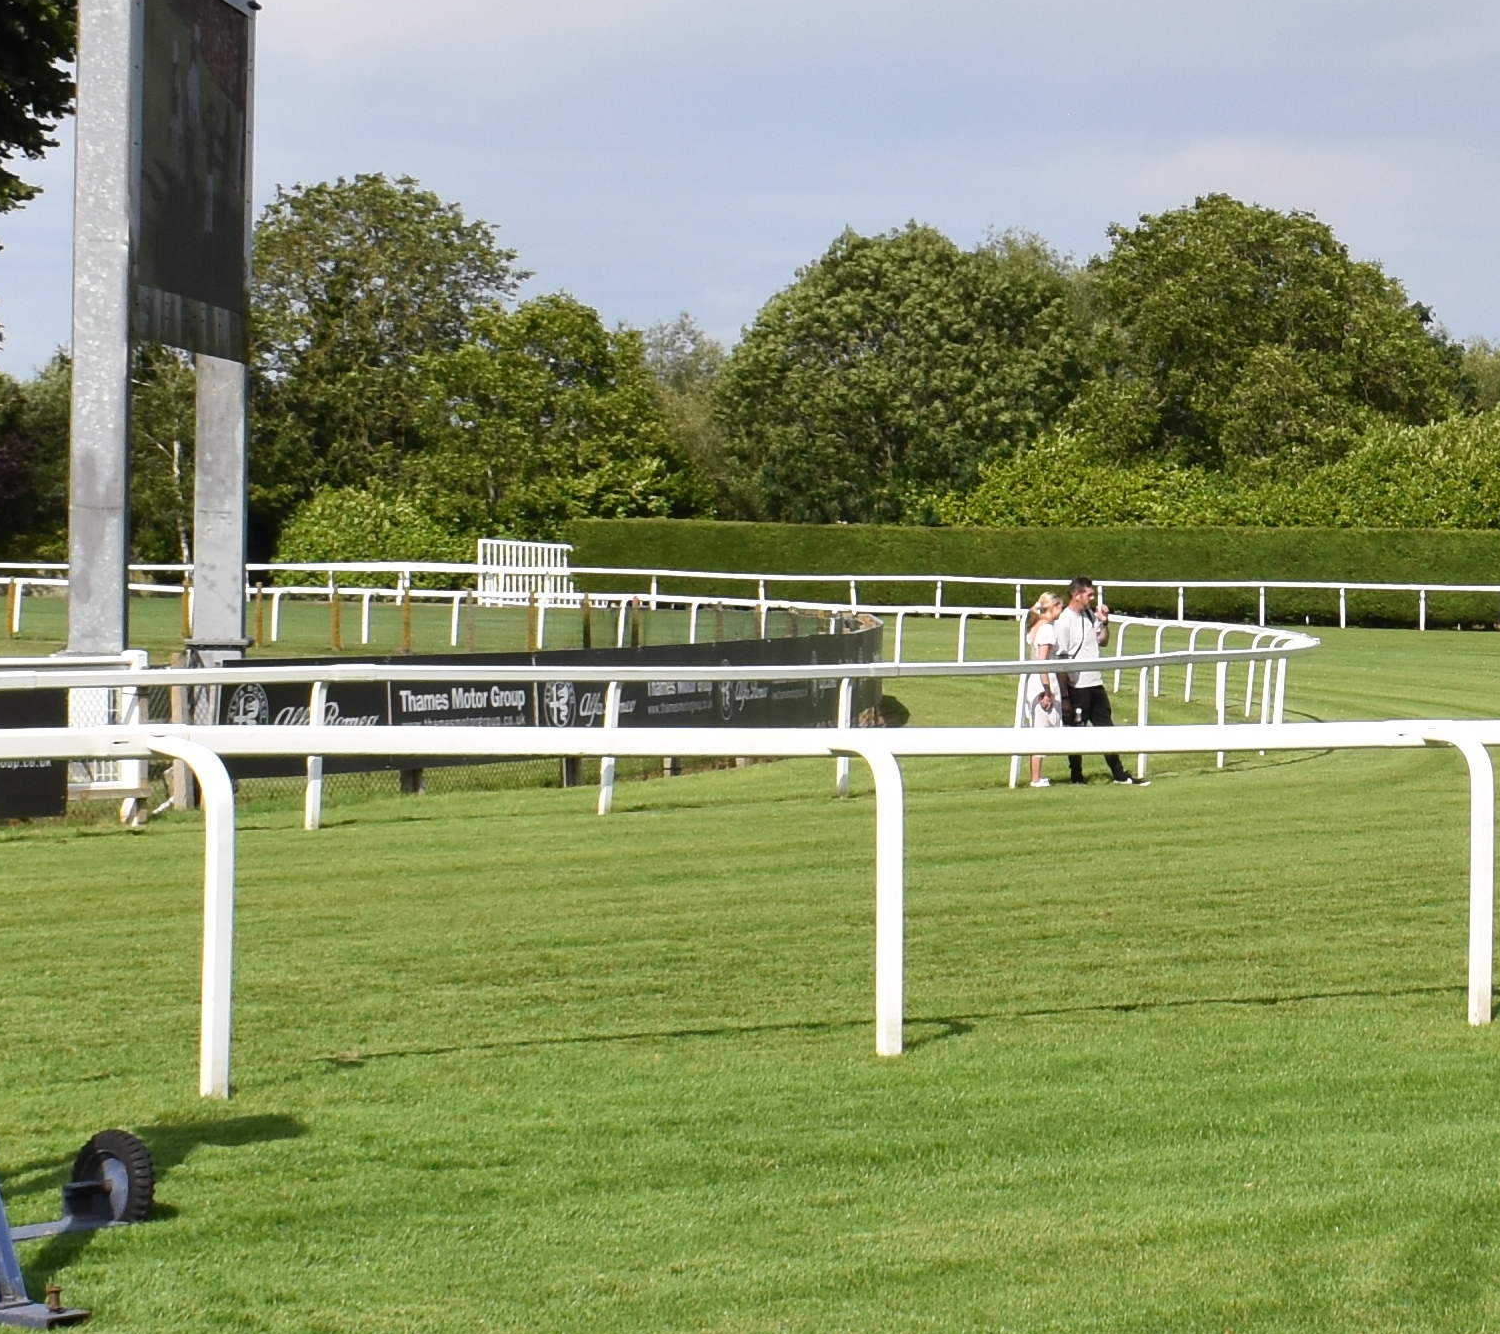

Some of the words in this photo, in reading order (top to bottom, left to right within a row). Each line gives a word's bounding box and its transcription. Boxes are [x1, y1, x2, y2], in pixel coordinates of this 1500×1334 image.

[399, 689, 449, 713] Thames
[451, 687, 488, 710] Motor
[490, 685, 526, 711] Group
[579, 692, 605, 727] Alfa
[274, 705, 311, 726] Alf
